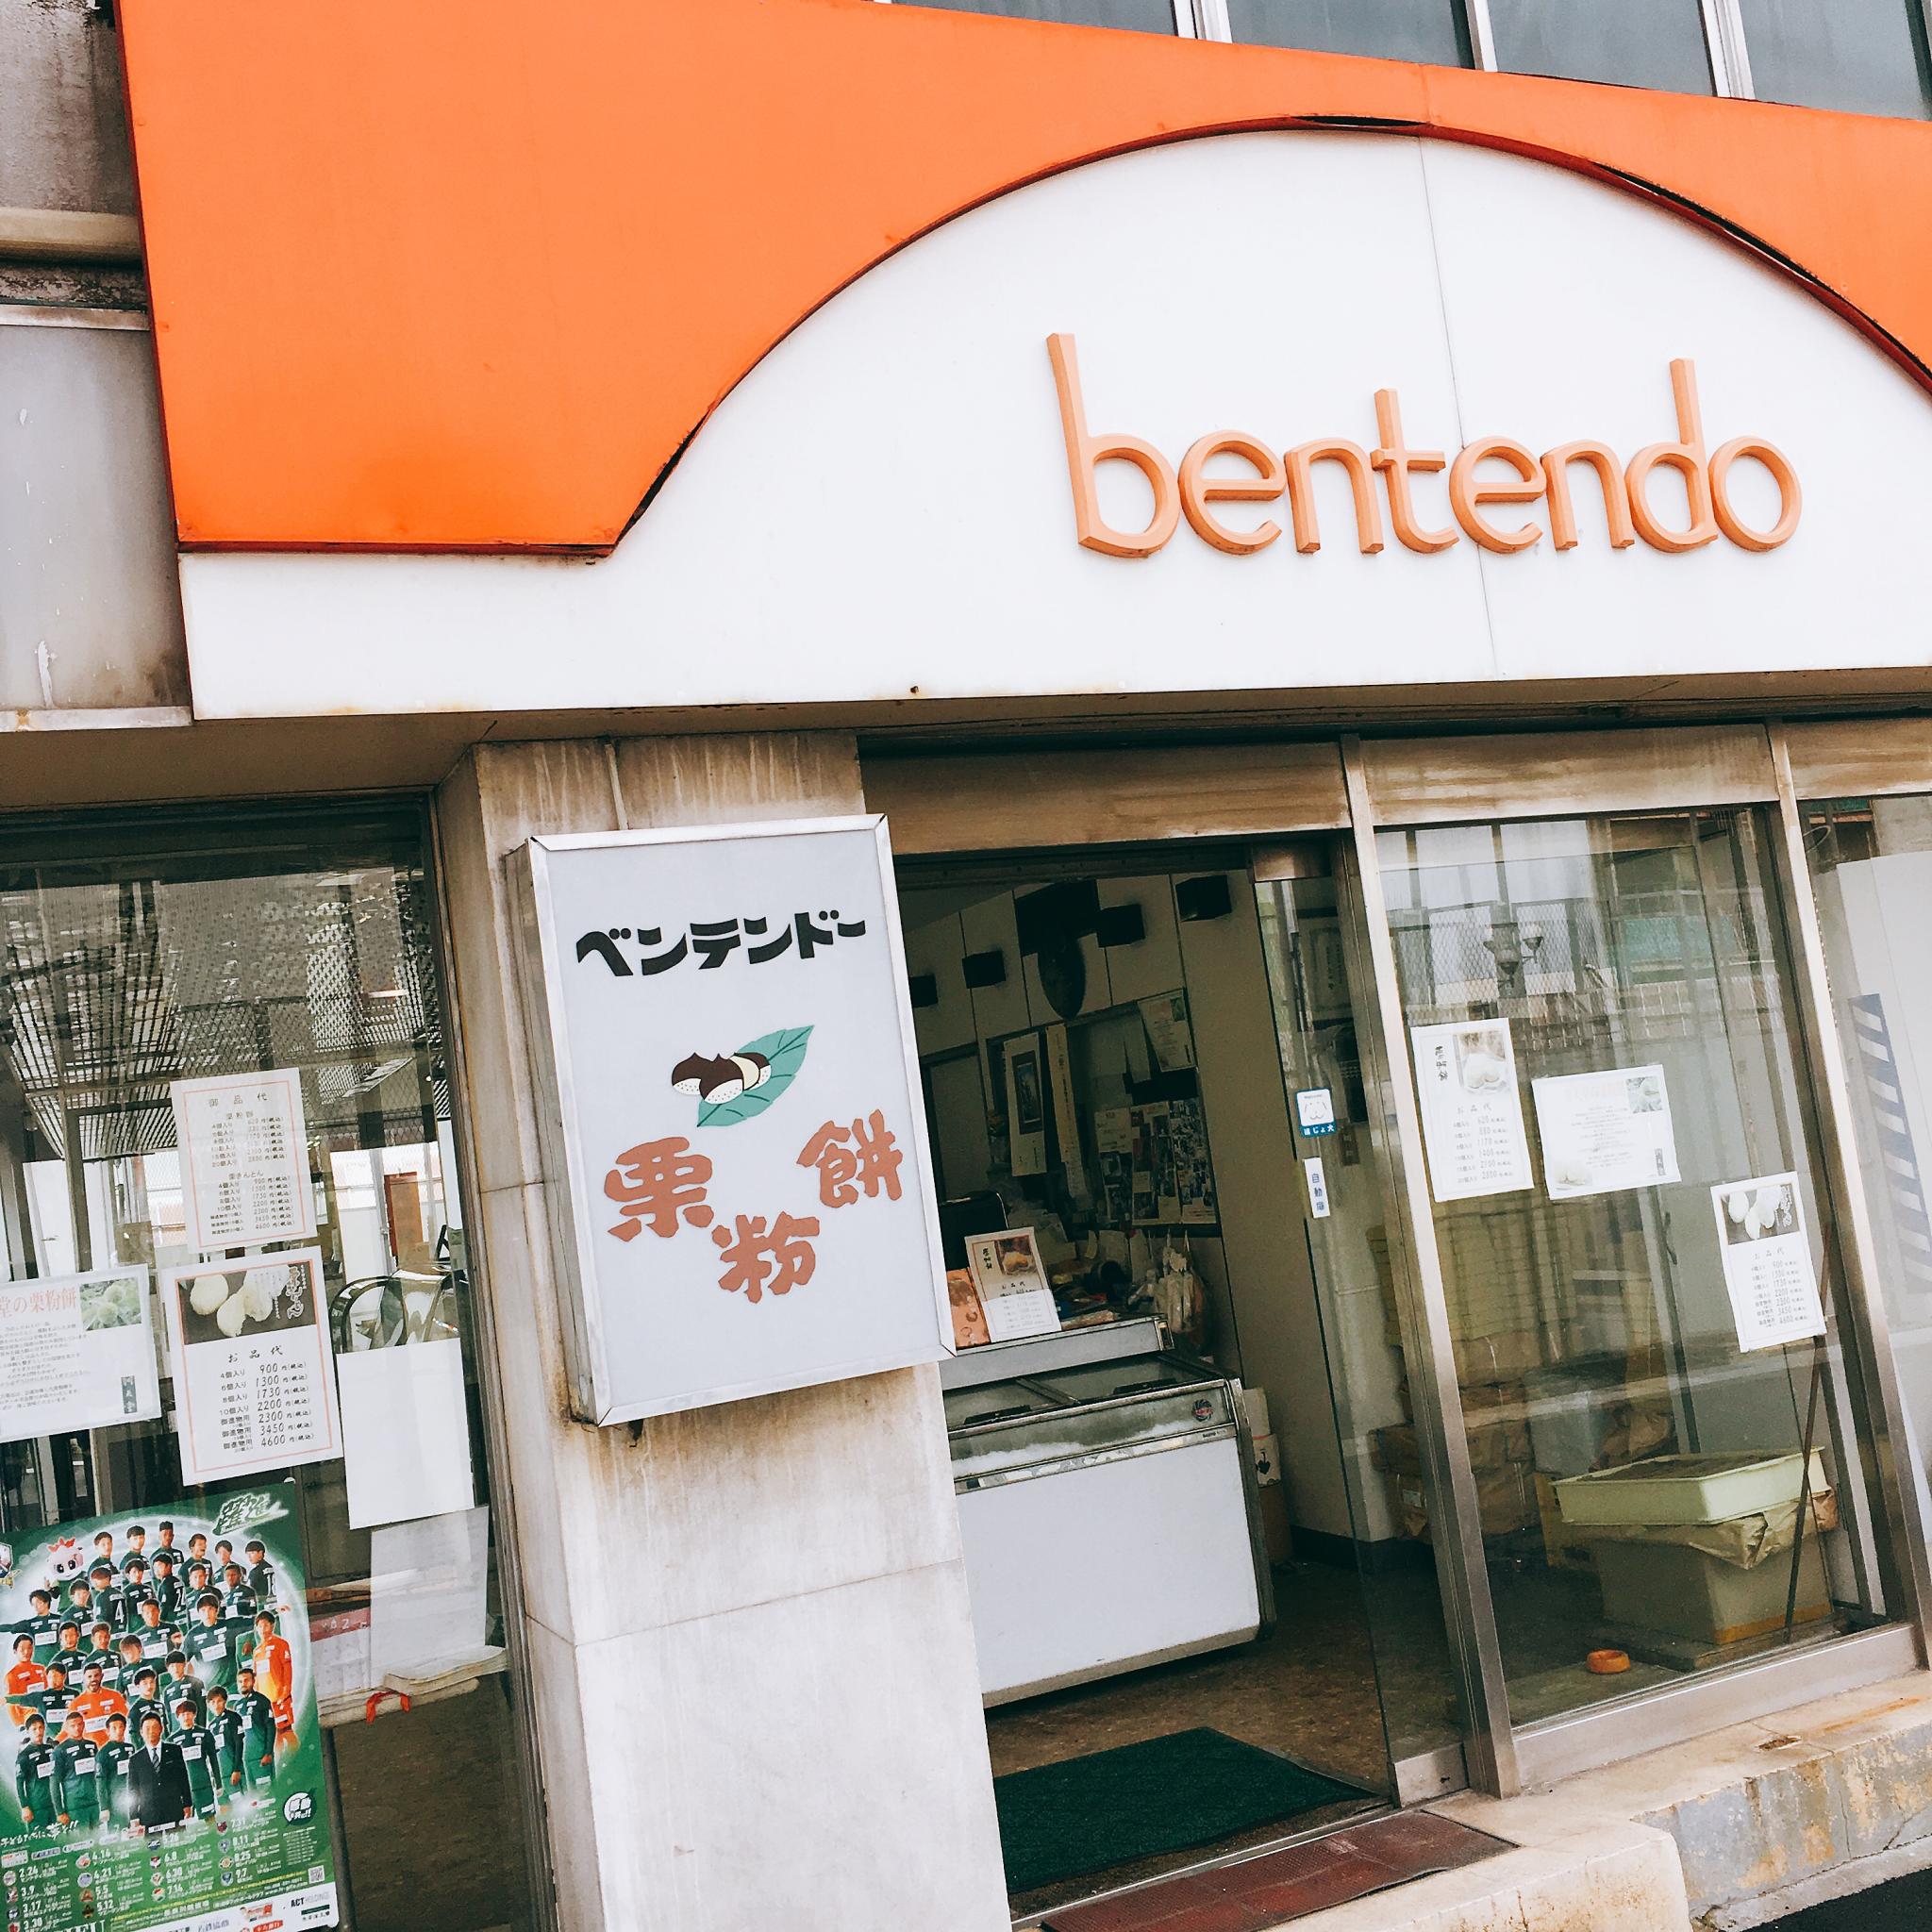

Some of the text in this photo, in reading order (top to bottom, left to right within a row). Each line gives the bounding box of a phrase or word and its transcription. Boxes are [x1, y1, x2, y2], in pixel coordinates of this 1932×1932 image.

[1046, 332, 1803, 558] bentendo
[576, 908, 866, 977] ベンテンドー
[604, 1108, 904, 1304] 栗粉餅
[259, 1363, 278, 1374] 900
[257, 1375, 279, 1388] 1300
[258, 1387, 281, 1400] 1730
[258, 1399, 282, 1411] 2200
[259, 1410, 283, 1424] 2300
[260, 1423, 285, 1436] 3450
[261, 1435, 286, 1447] 4600
[115, 1600, 125, 1624] 4
